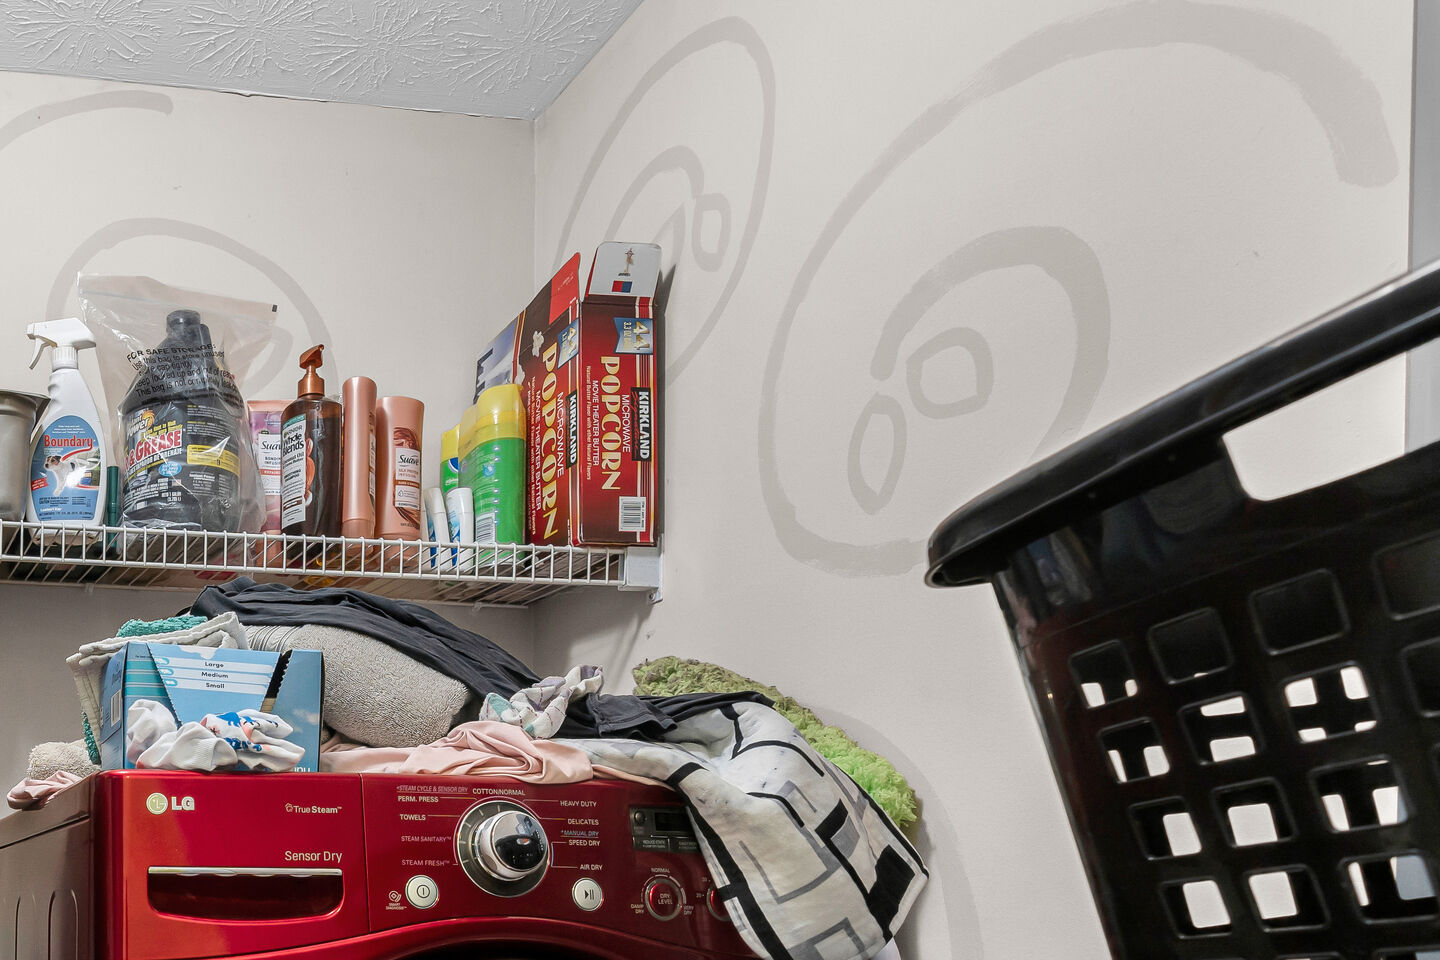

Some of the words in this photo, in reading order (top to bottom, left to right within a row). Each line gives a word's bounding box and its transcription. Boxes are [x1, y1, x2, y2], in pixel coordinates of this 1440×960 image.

[126, 351, 144, 362] FOR
[146, 347, 170, 356] SAFE
[569, 394, 577, 464] KIRKLAND
[601, 356, 621, 490] POPCORN
[622, 394, 630, 453] MICROWAVE
[639, 391, 650, 459] KIRKLAND
[44, 435, 93, 450] Boundary
[135, 430, 182, 462] GREASE
[542, 342, 558, 540] POPCORN
[398, 454, 419, 466] Suave
[201, 671, 229, 679] Medium
[472, 788, 525, 796] COTTON/NORMAL
[171, 796, 195, 811] LG
[400, 813, 426, 821] TOWELS
[285, 851, 321, 861] Sensor
[323, 851, 342, 864] Dry
